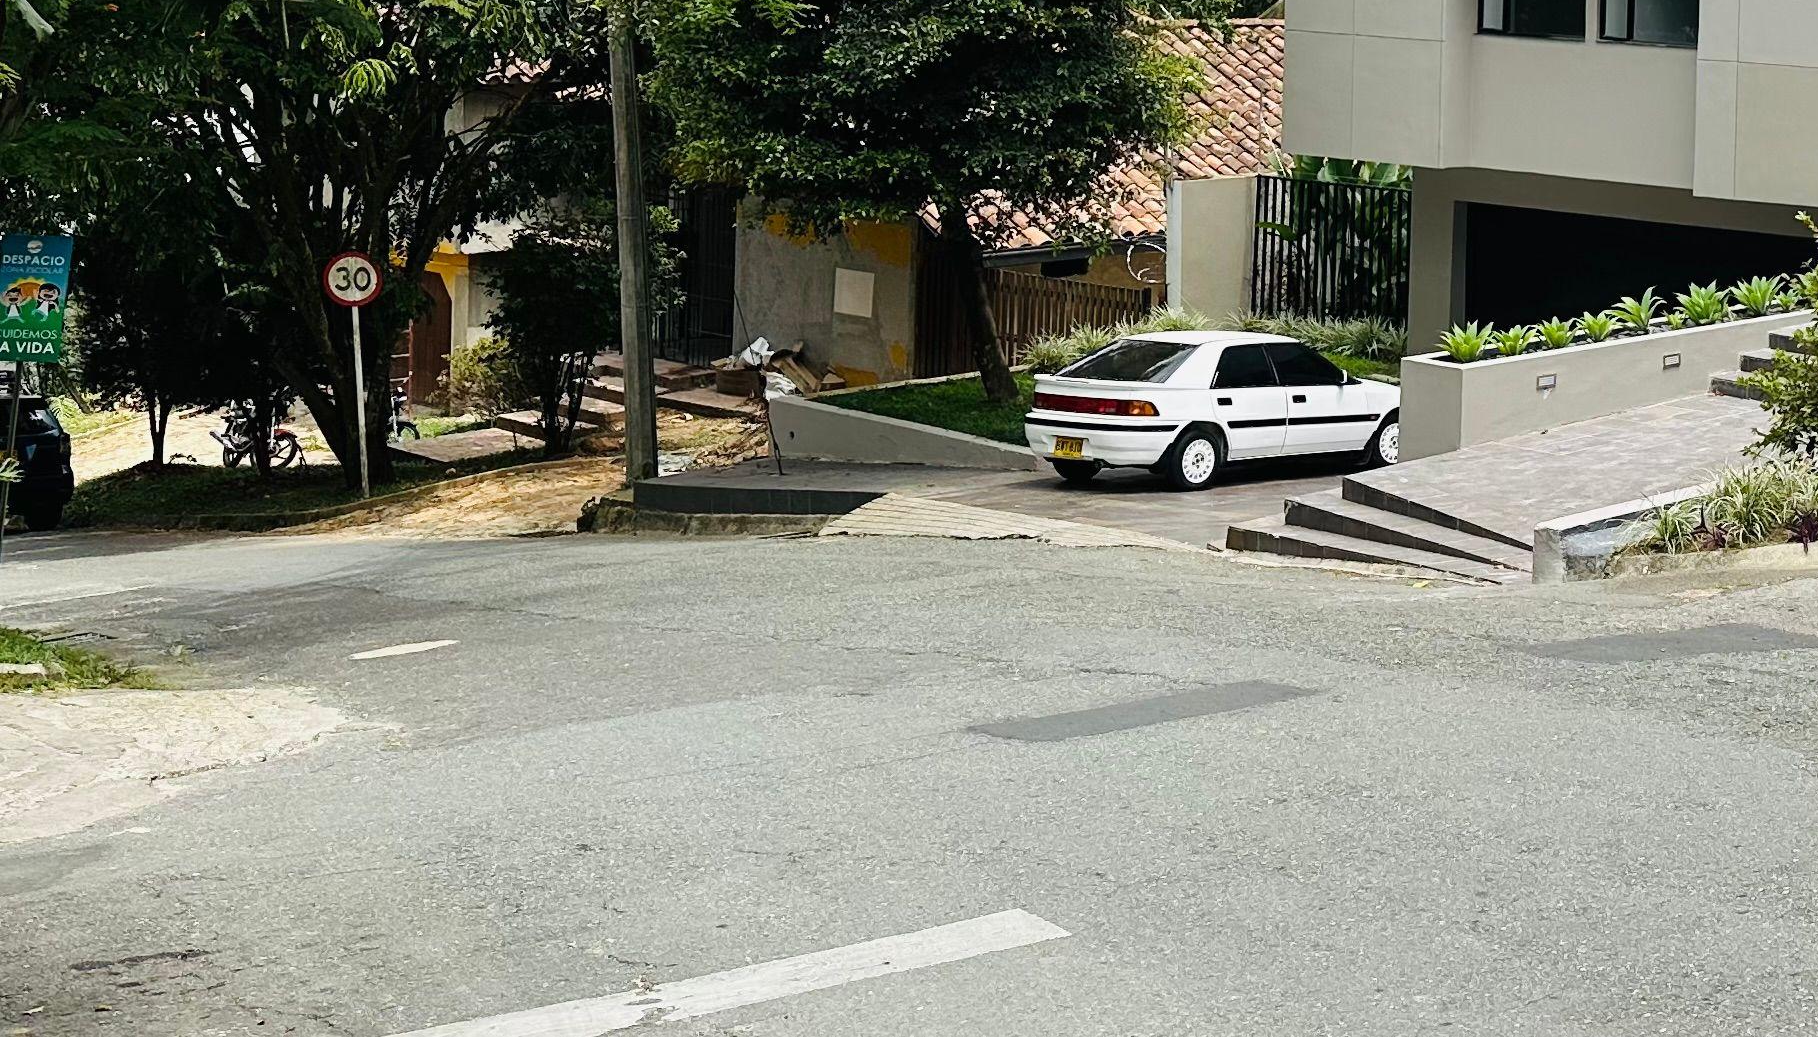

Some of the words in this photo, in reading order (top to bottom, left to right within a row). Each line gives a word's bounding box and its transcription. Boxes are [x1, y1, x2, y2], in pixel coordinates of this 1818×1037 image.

[2, 254, 65, 266] DESPACIO
[335, 266, 371, 291] 30
[16, 341, 55, 354] VIDA
